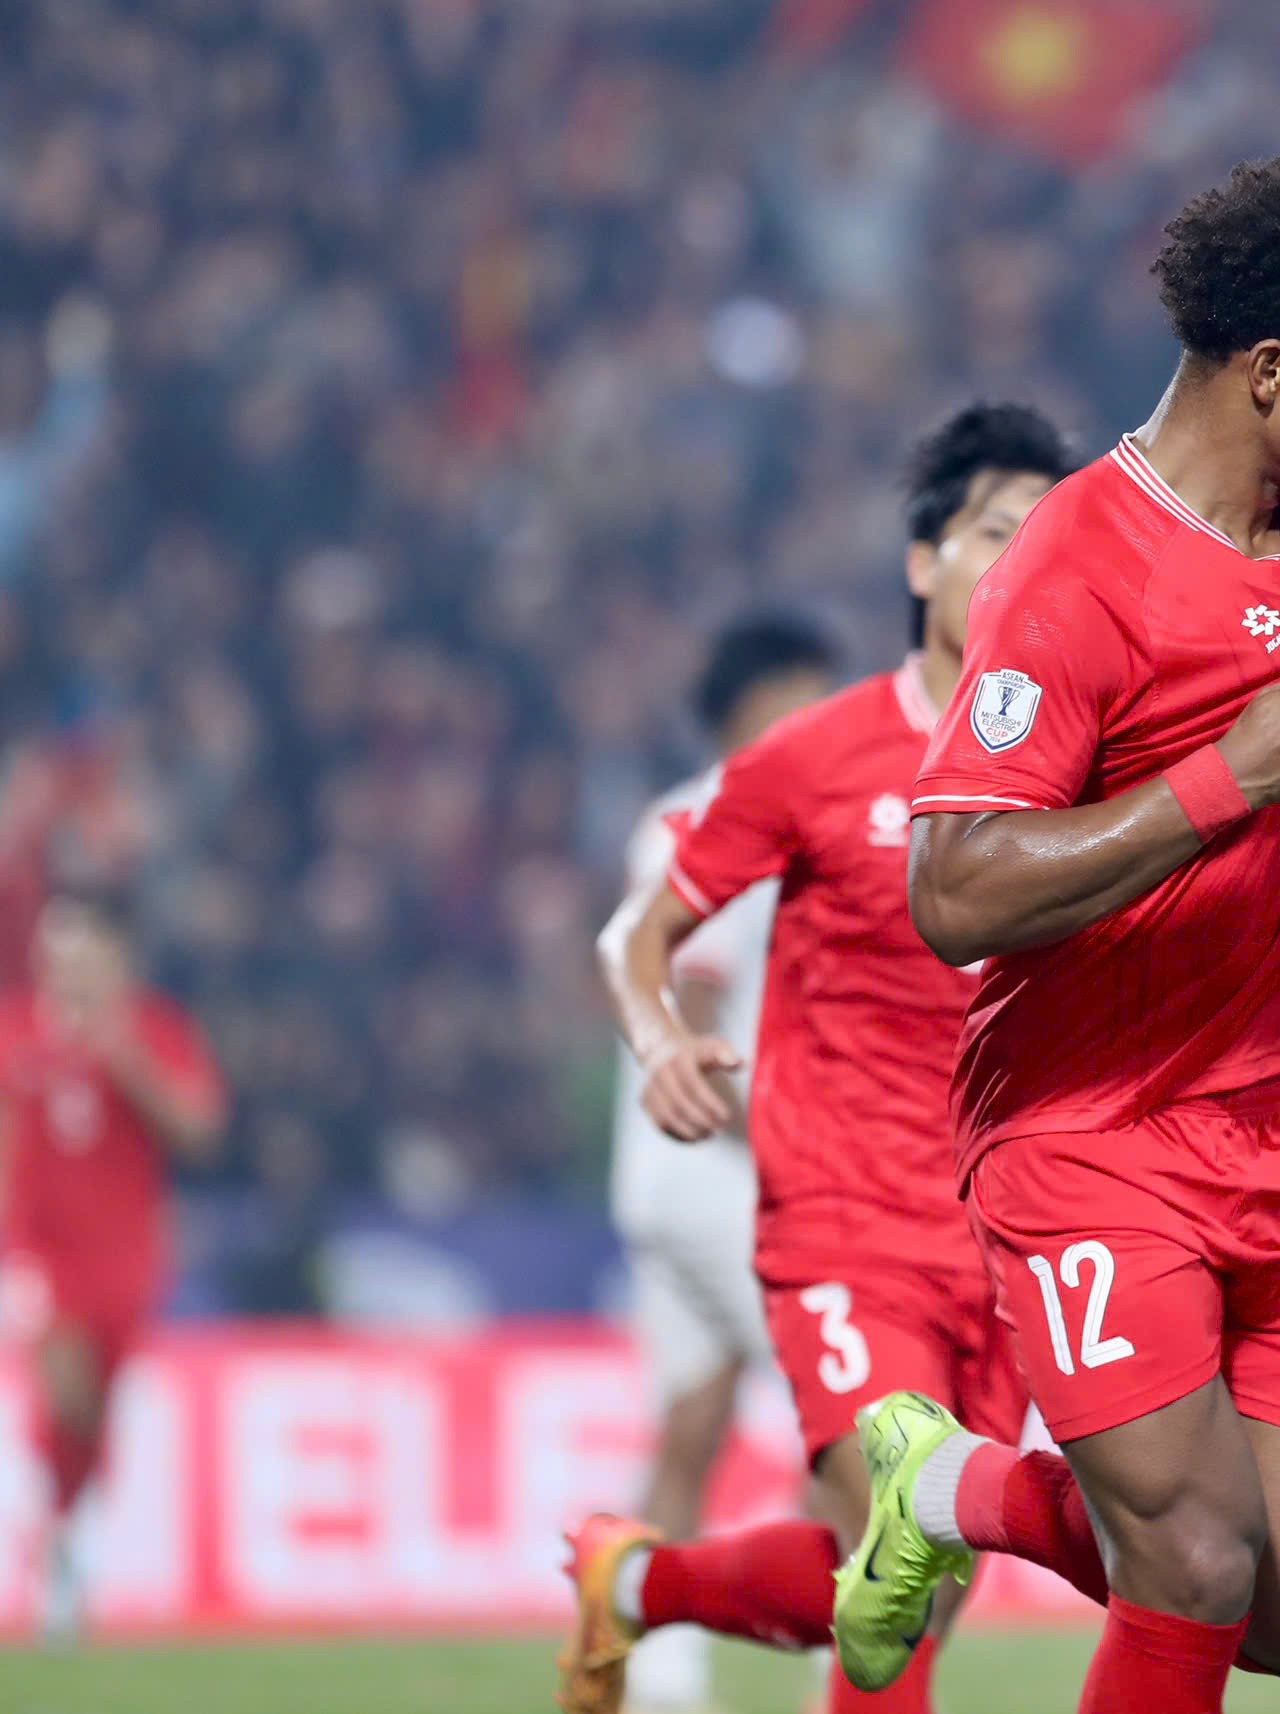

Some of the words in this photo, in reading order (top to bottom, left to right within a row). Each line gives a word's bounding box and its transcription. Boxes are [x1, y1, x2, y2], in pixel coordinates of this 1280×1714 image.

[1002, 671, 1025, 683] ASEAN
[982, 718, 1017, 733] ELECTRIC
[985, 727, 1009, 738] CUP
[1027, 1240, 1135, 1375] 12
[800, 1281, 872, 1395] 3
